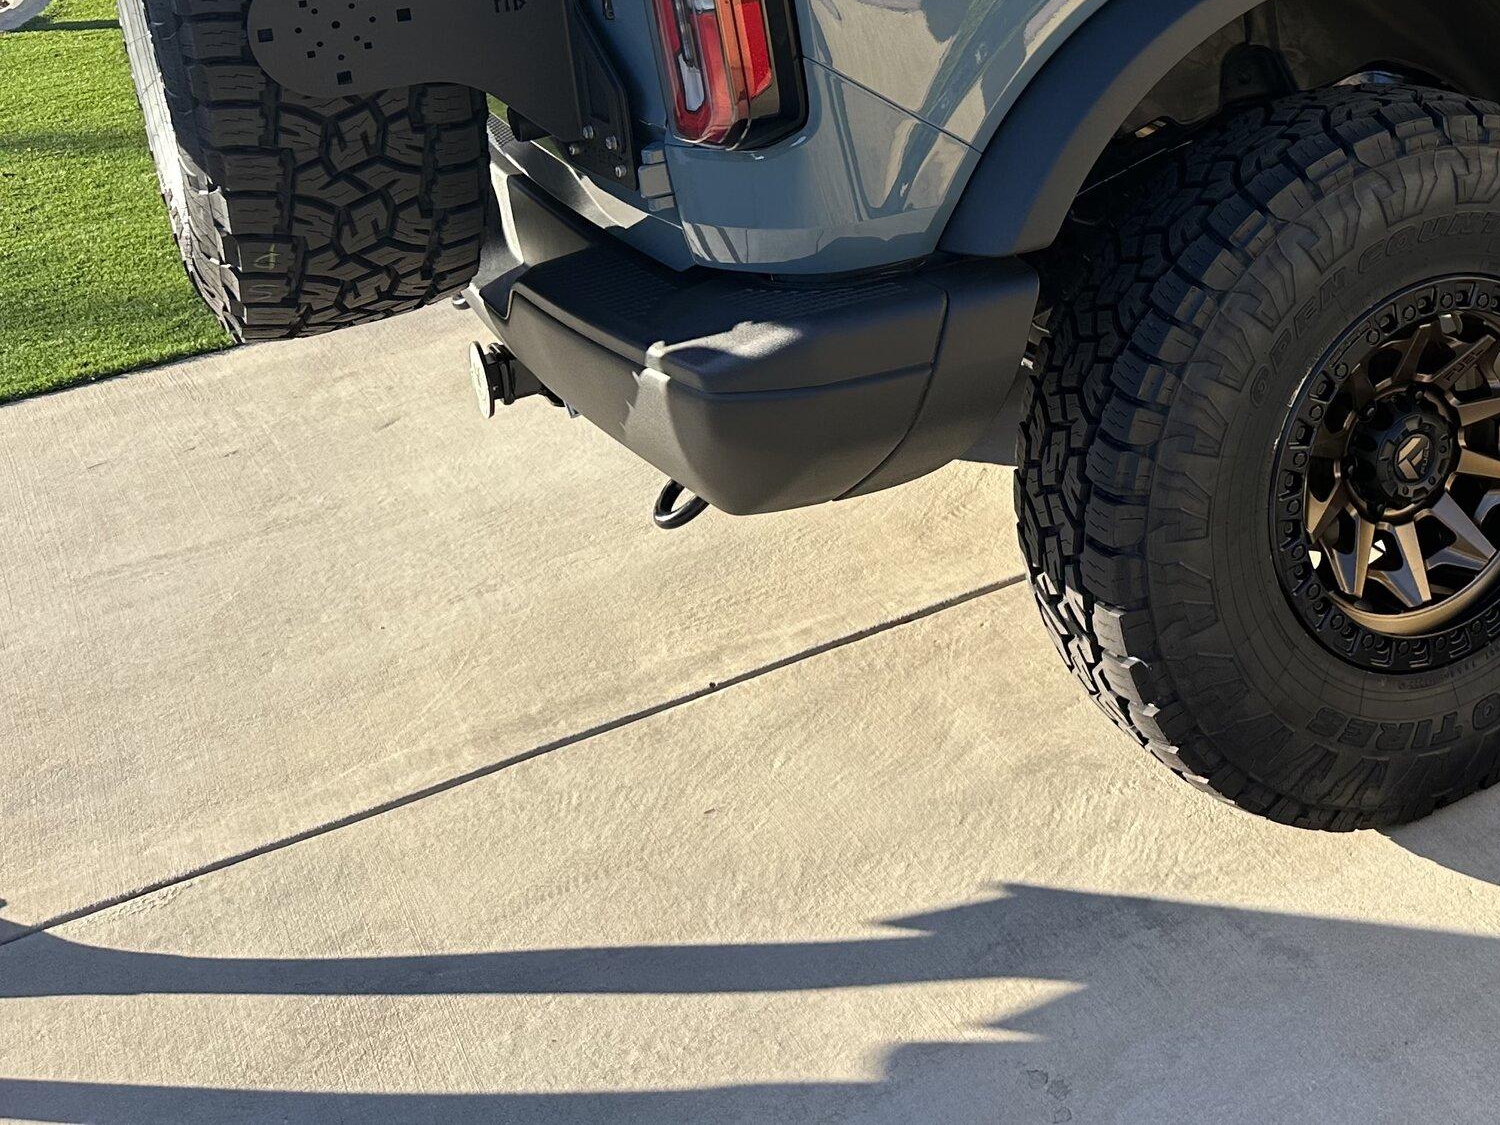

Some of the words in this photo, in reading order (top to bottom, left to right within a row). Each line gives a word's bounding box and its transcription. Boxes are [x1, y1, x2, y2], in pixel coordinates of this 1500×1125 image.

[1248, 265, 1349, 408] OPEN
[1443, 348, 1484, 382] FUEL
[1305, 705, 1464, 752] TIRES
